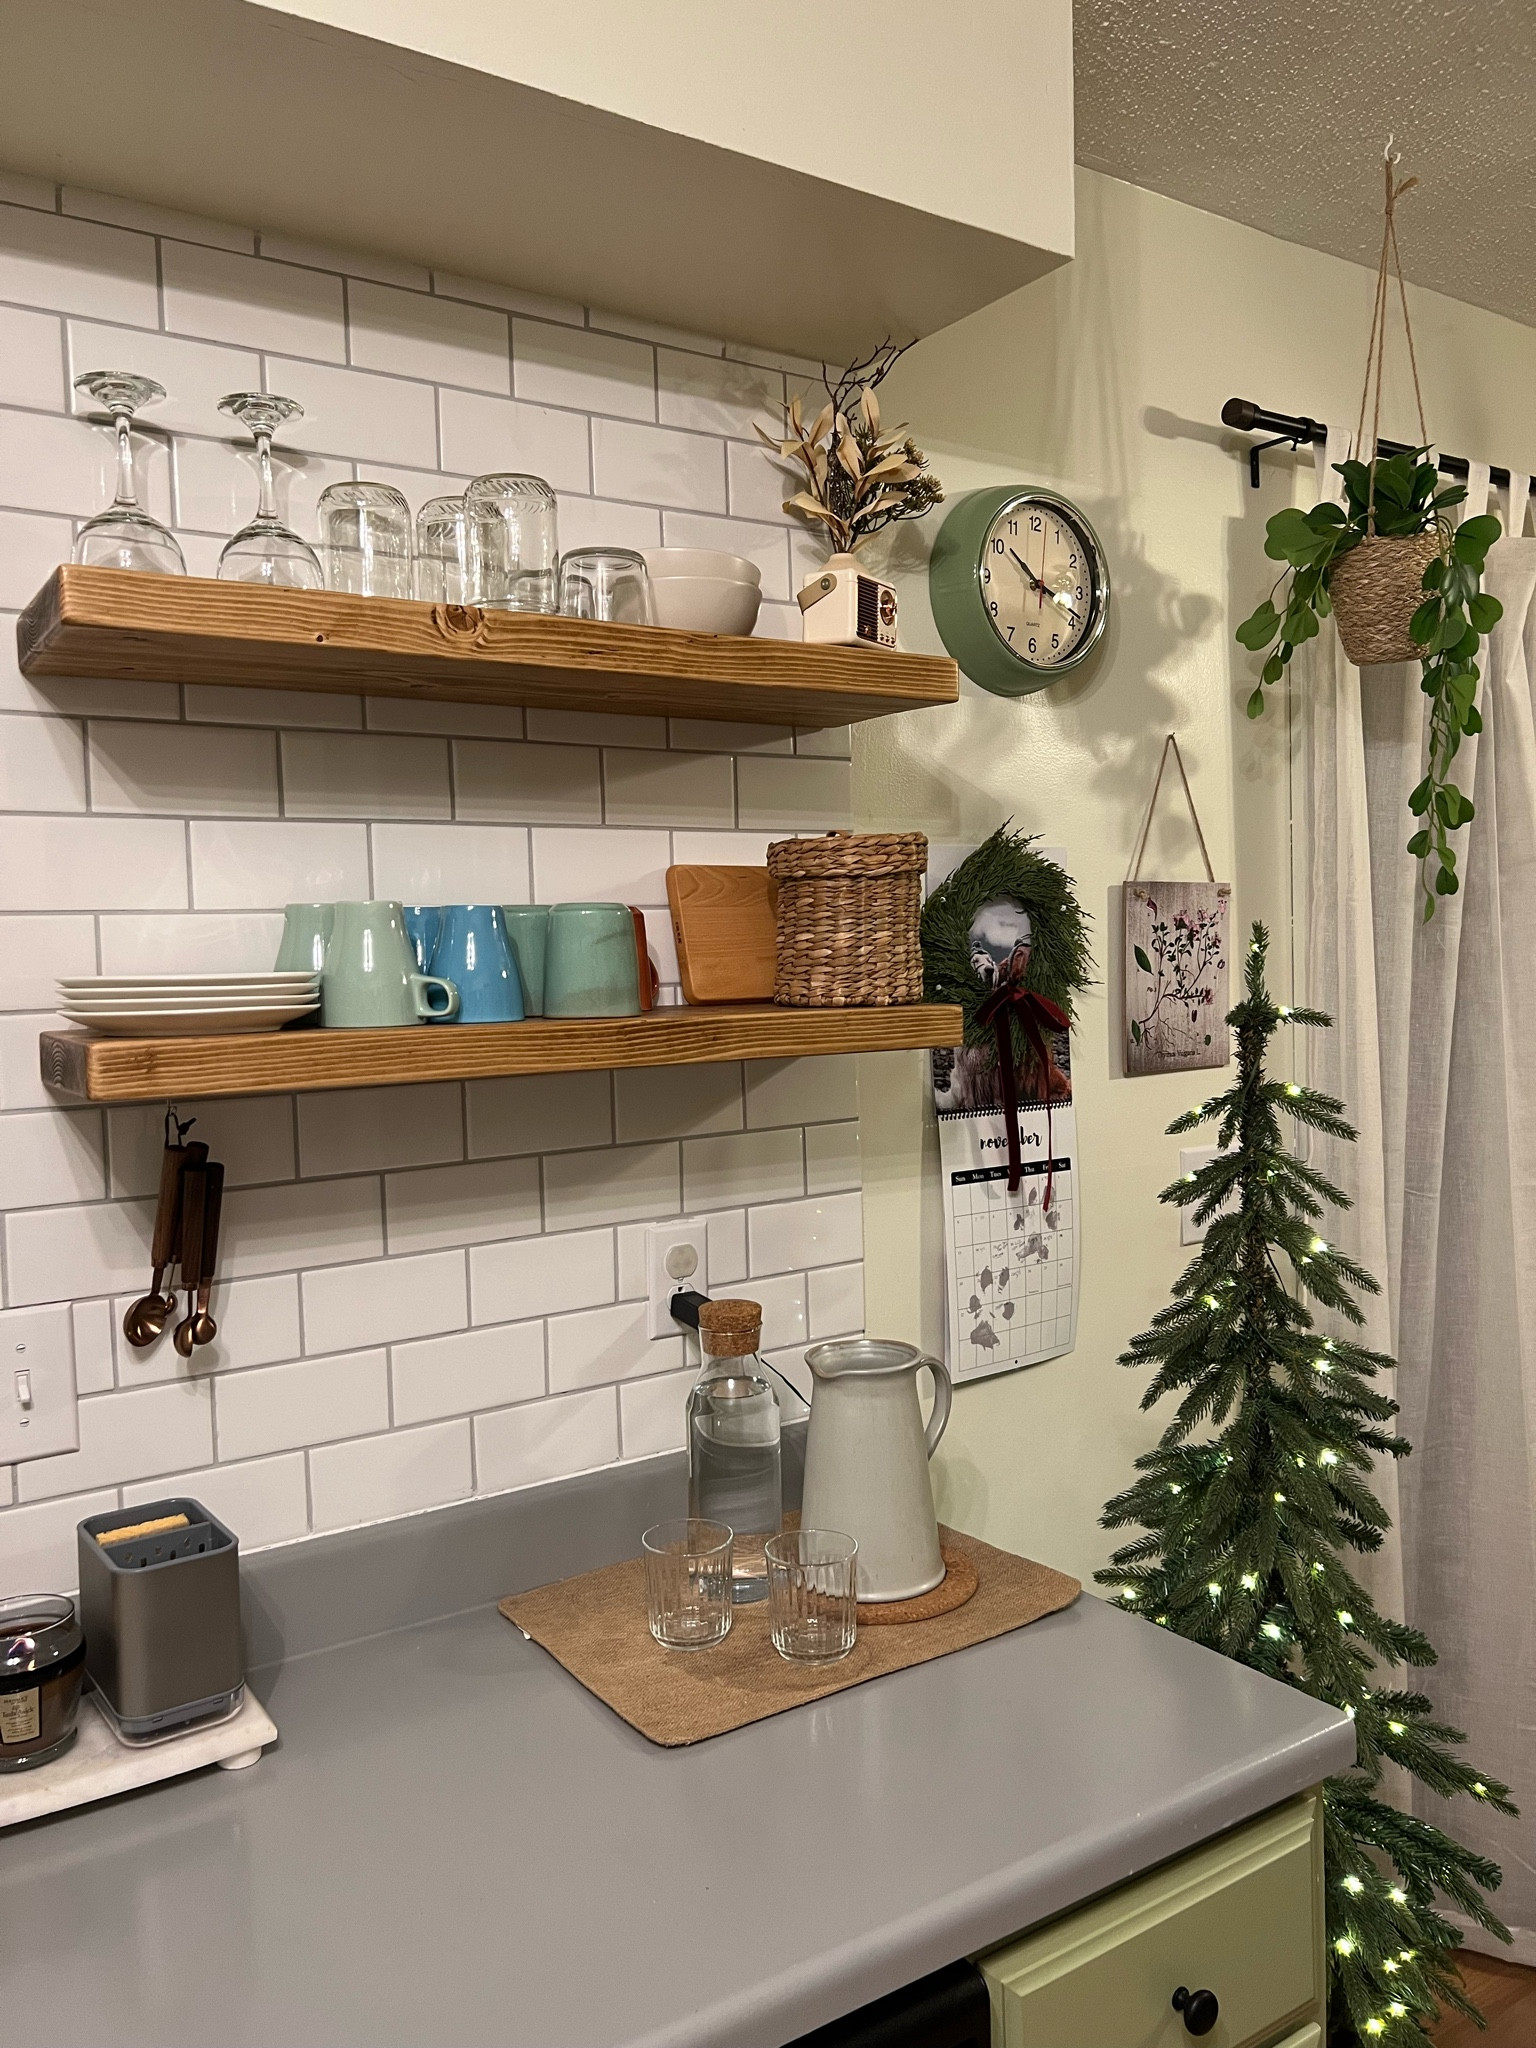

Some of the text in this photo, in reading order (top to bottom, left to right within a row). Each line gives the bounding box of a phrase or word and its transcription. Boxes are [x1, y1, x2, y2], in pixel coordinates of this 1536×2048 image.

[1007, 519, 1018, 536] 11
[1029, 515, 1042, 532] 12
[1054, 529, 1060, 544] 1
[991, 538, 1005, 554] 10
[1069, 554, 1077, 569] 2
[984, 568, 991, 584] 9
[1075, 586, 1083, 600] 3
[990, 601, 998, 617] 8
[1068, 616, 1076, 630] 4
[1006, 626, 1015, 642] 7
[1051, 633, 1059, 648] 5
[1028, 637, 1037, 653] 6
[980, 1126, 1042, 1150] noveber
[972, 1172, 985, 1180] Mon
[989, 1170, 1002, 1178] Tues
[1042, 1163, 1050, 1171] Fr
[1058, 1161, 1067, 1169] Sat
